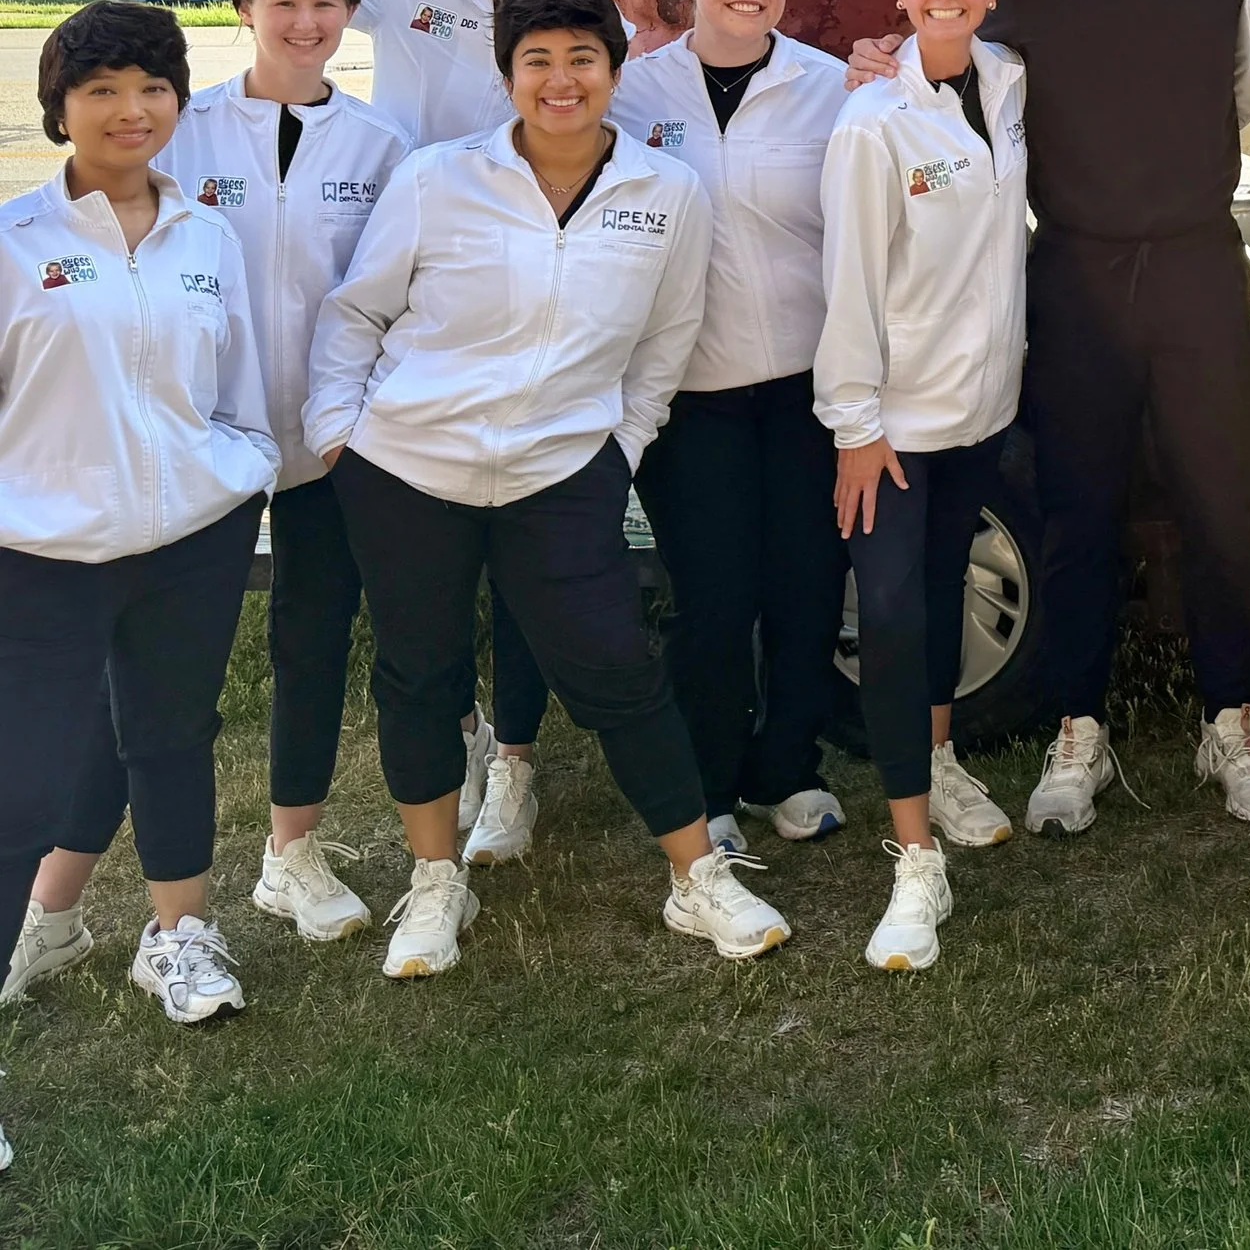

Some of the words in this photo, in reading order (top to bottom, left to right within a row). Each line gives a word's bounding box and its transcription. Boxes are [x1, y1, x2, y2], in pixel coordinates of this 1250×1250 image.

[460, 18, 479, 30] DDS
[953, 158, 971, 171] DDS
[618, 211, 668, 227] PENZ
[617, 224, 645, 233] DENTAL
[79, 268, 95, 280] 40
